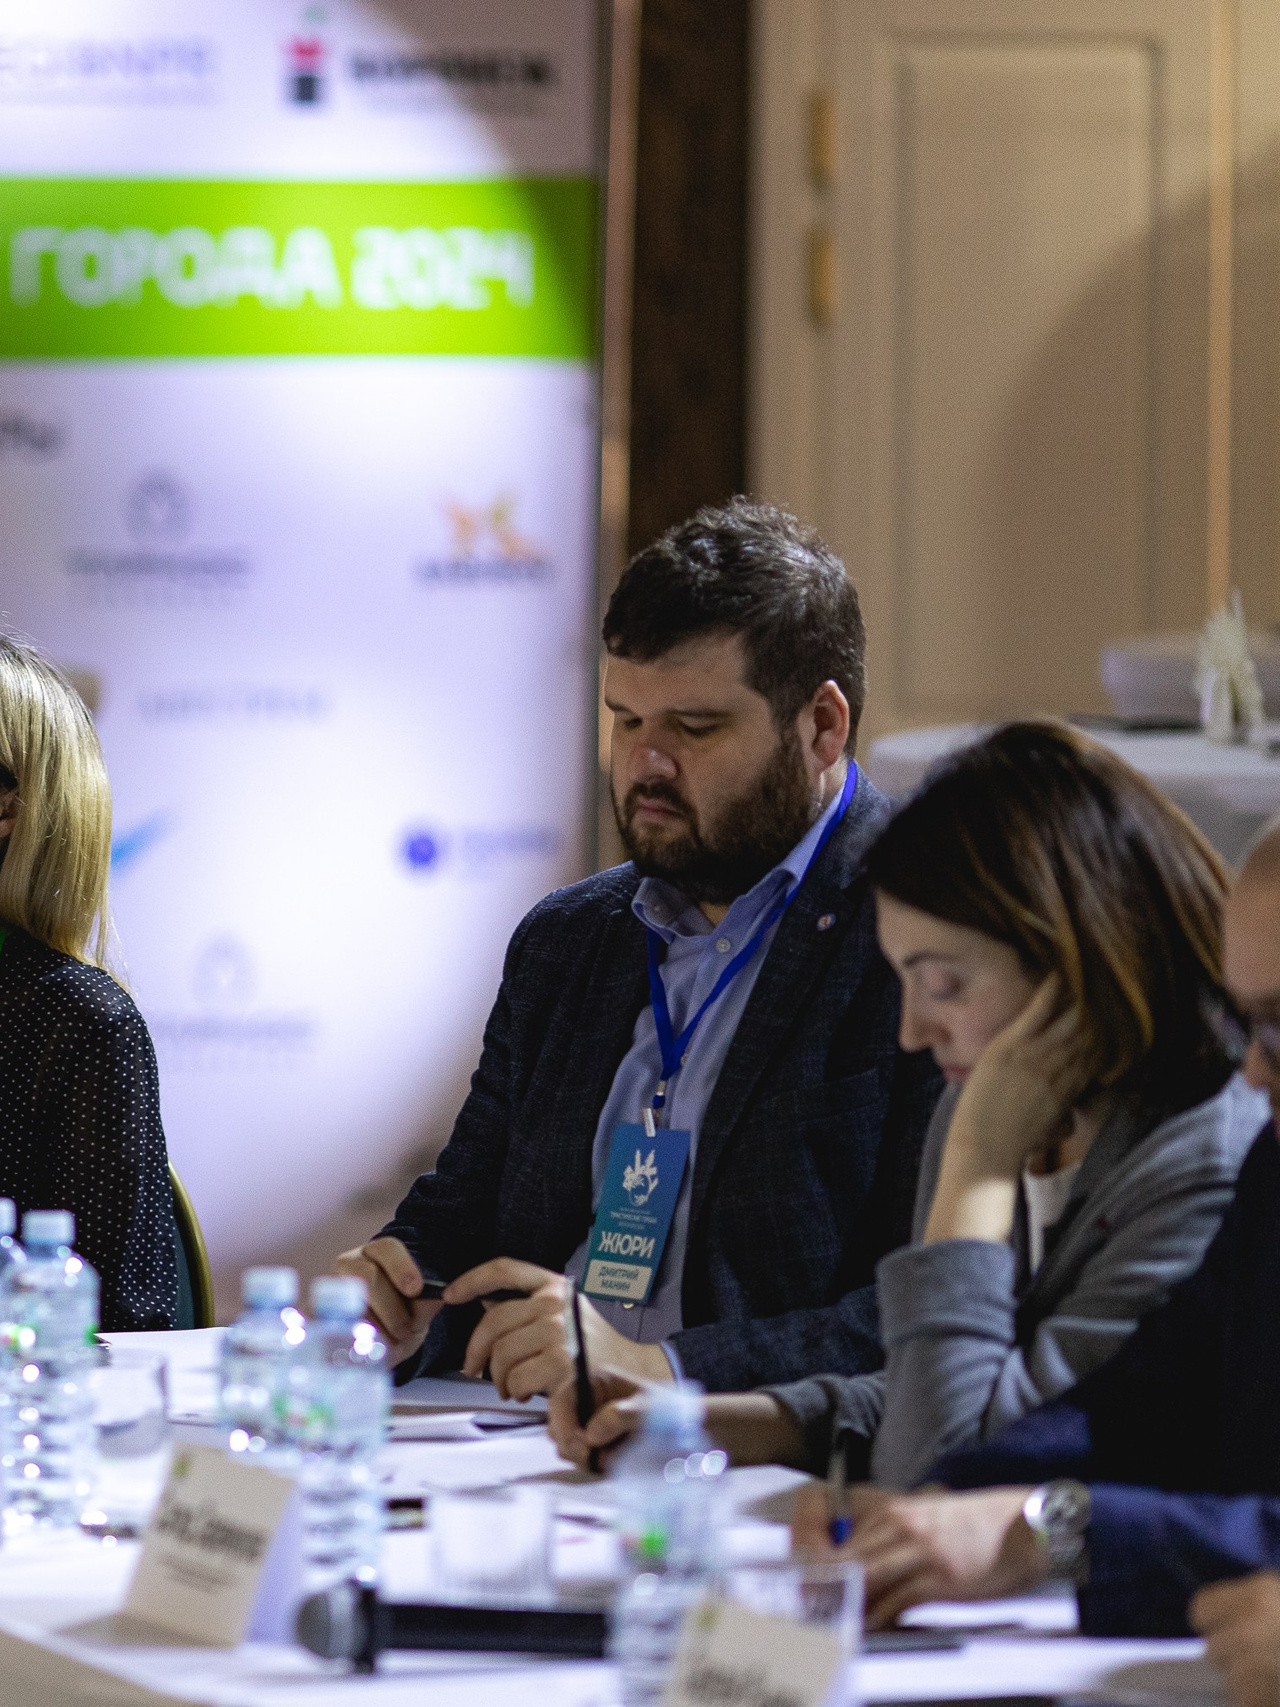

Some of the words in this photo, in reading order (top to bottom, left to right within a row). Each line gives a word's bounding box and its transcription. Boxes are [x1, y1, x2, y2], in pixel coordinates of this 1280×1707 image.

[10, 225, 343, 308] ГОРОДА
[351, 225, 535, 310] 2024
[597, 1230, 656, 1259] ЖЮРИ
[598, 1265, 640, 1280] ДМИТРИЙ
